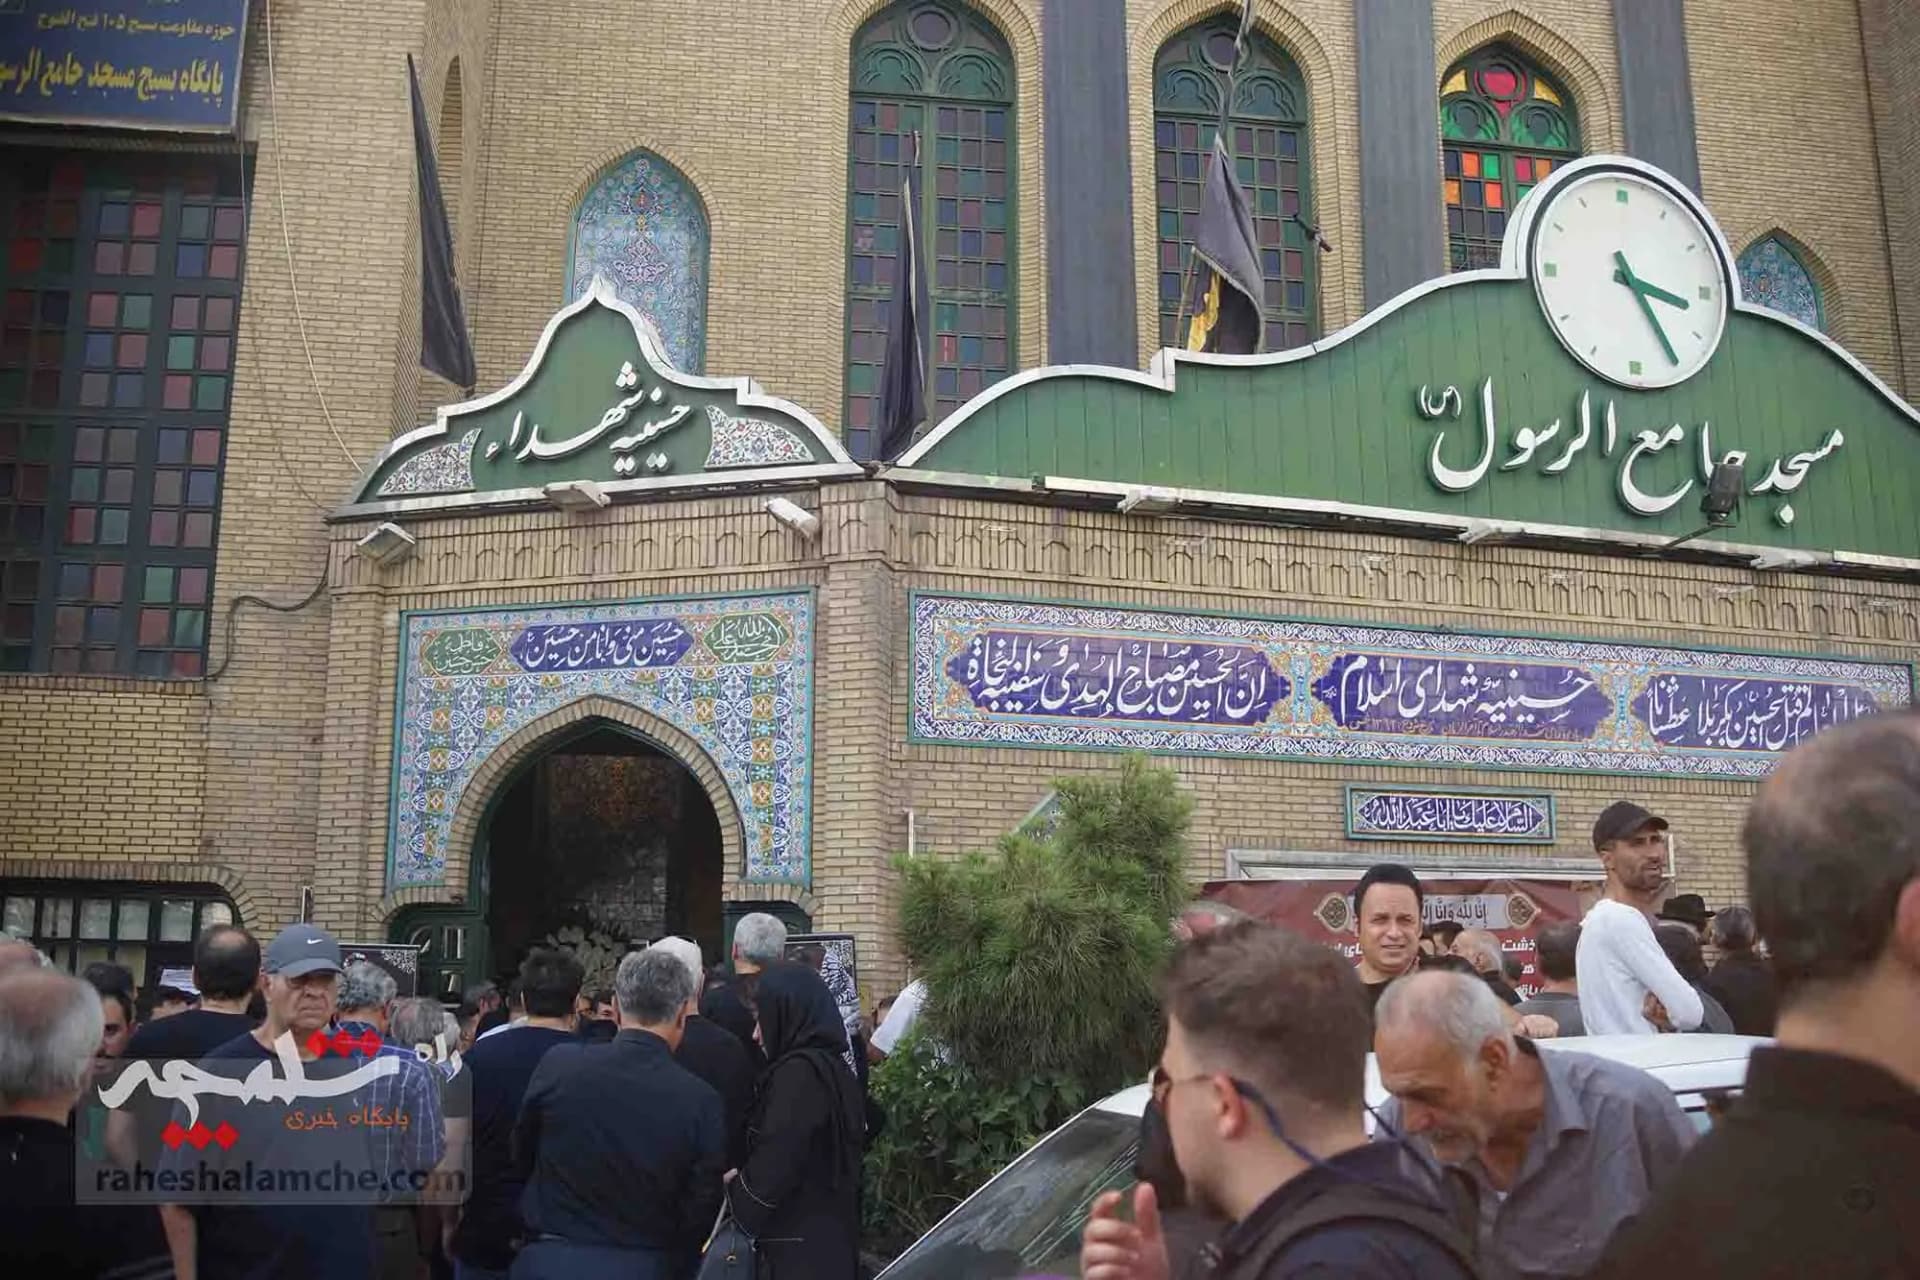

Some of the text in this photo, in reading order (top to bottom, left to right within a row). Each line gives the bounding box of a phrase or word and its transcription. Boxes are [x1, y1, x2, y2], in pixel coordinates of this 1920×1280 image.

[40, 51, 83, 96] جامع
[88, 60, 135, 98] مسجد
[137, 62, 176, 101] بسیج
[180, 59, 223, 108] پایگاه
[609, 386, 692, 478] حسینیه
[1427, 375, 1618, 494] الرسول
[1747, 427, 1847, 529] مسجد
[1341, 655, 1595, 724] حسینیه شهدای اسلام
